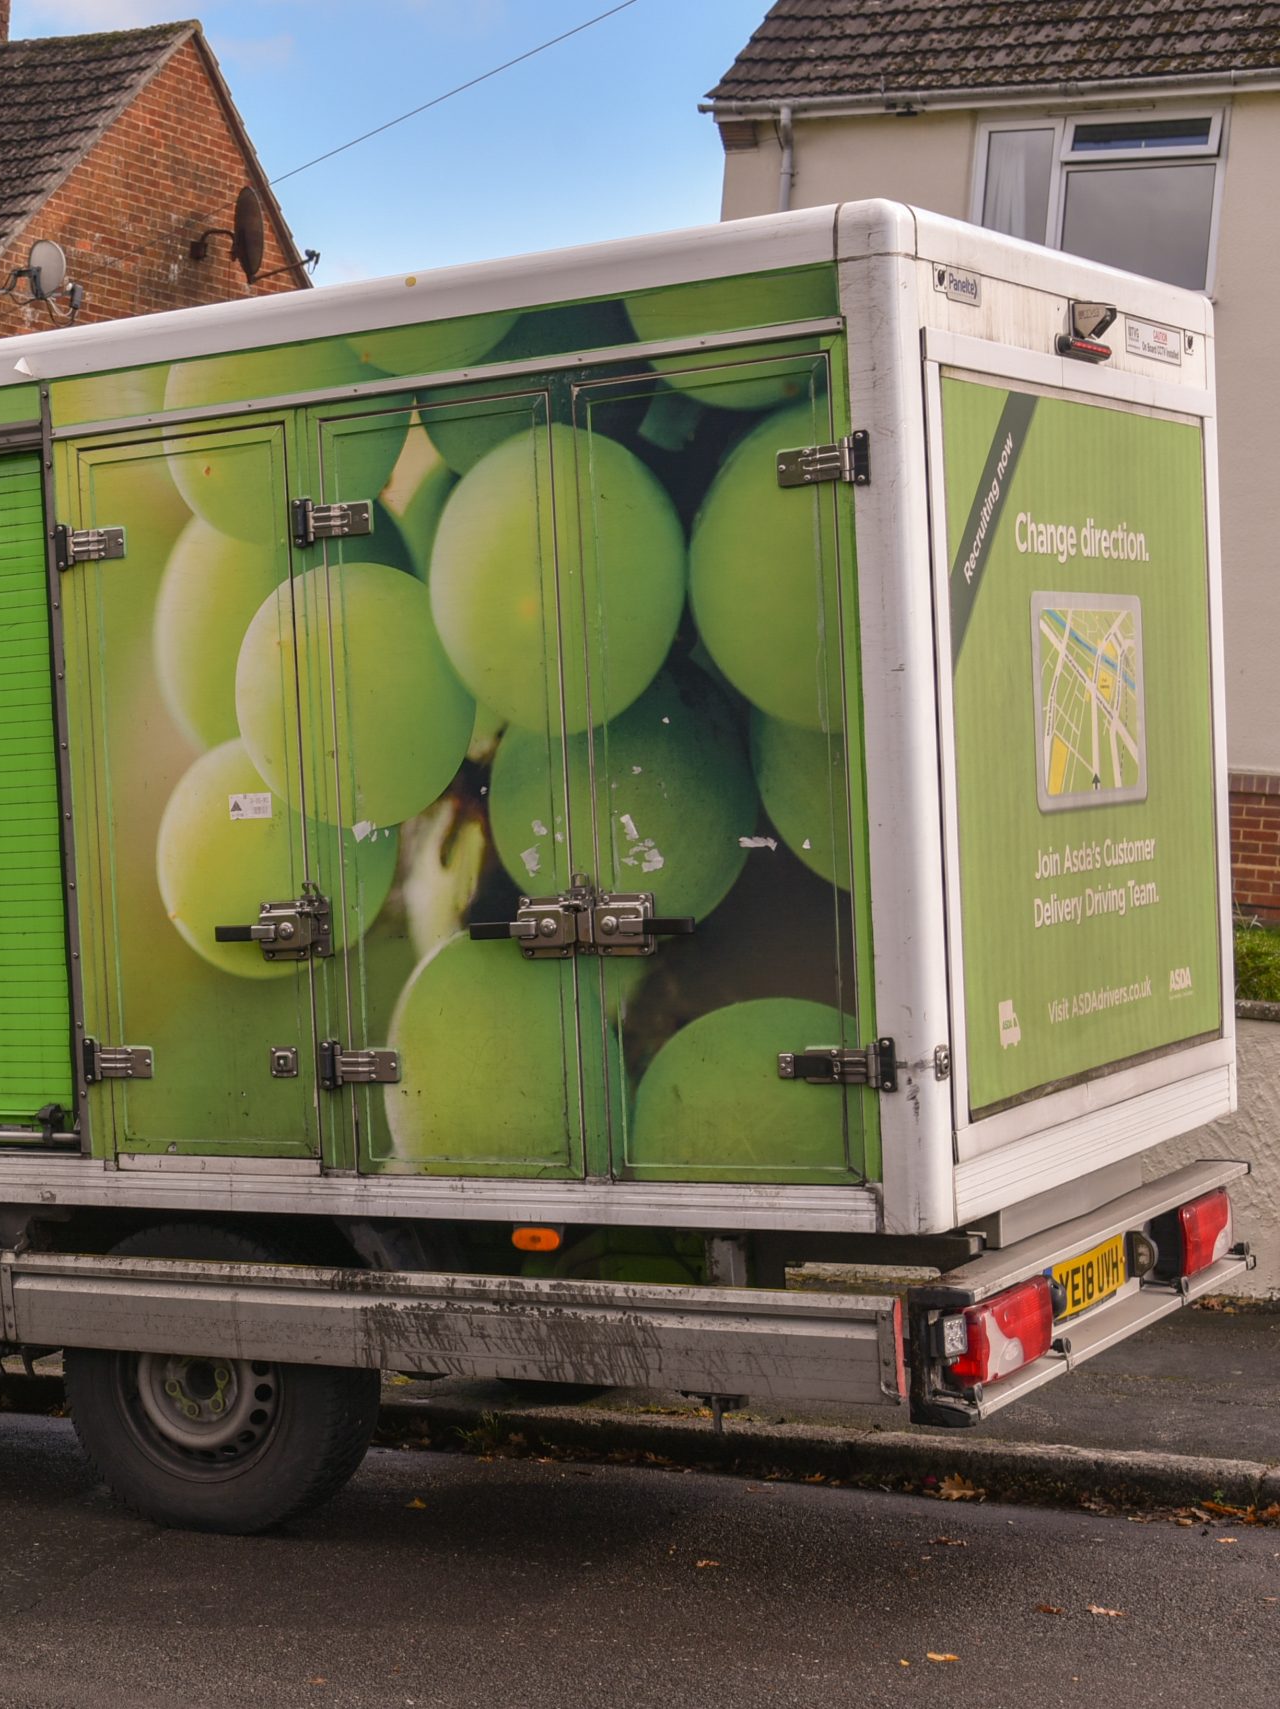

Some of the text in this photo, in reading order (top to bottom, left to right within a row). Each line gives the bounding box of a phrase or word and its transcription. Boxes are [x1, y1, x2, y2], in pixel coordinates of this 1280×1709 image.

[963, 431, 1014, 584] Recruiting now
[1015, 512, 1150, 564] Change direction.
[1035, 837, 1156, 880] Join Asda's Customer
[1034, 880, 1160, 928] Delivery Driving Team.
[1047, 975, 1153, 1024] Visit ASDAdrivers.co.uk
[1169, 966, 1193, 992] ASDA
[1059, 1260, 1095, 1308] YE18
